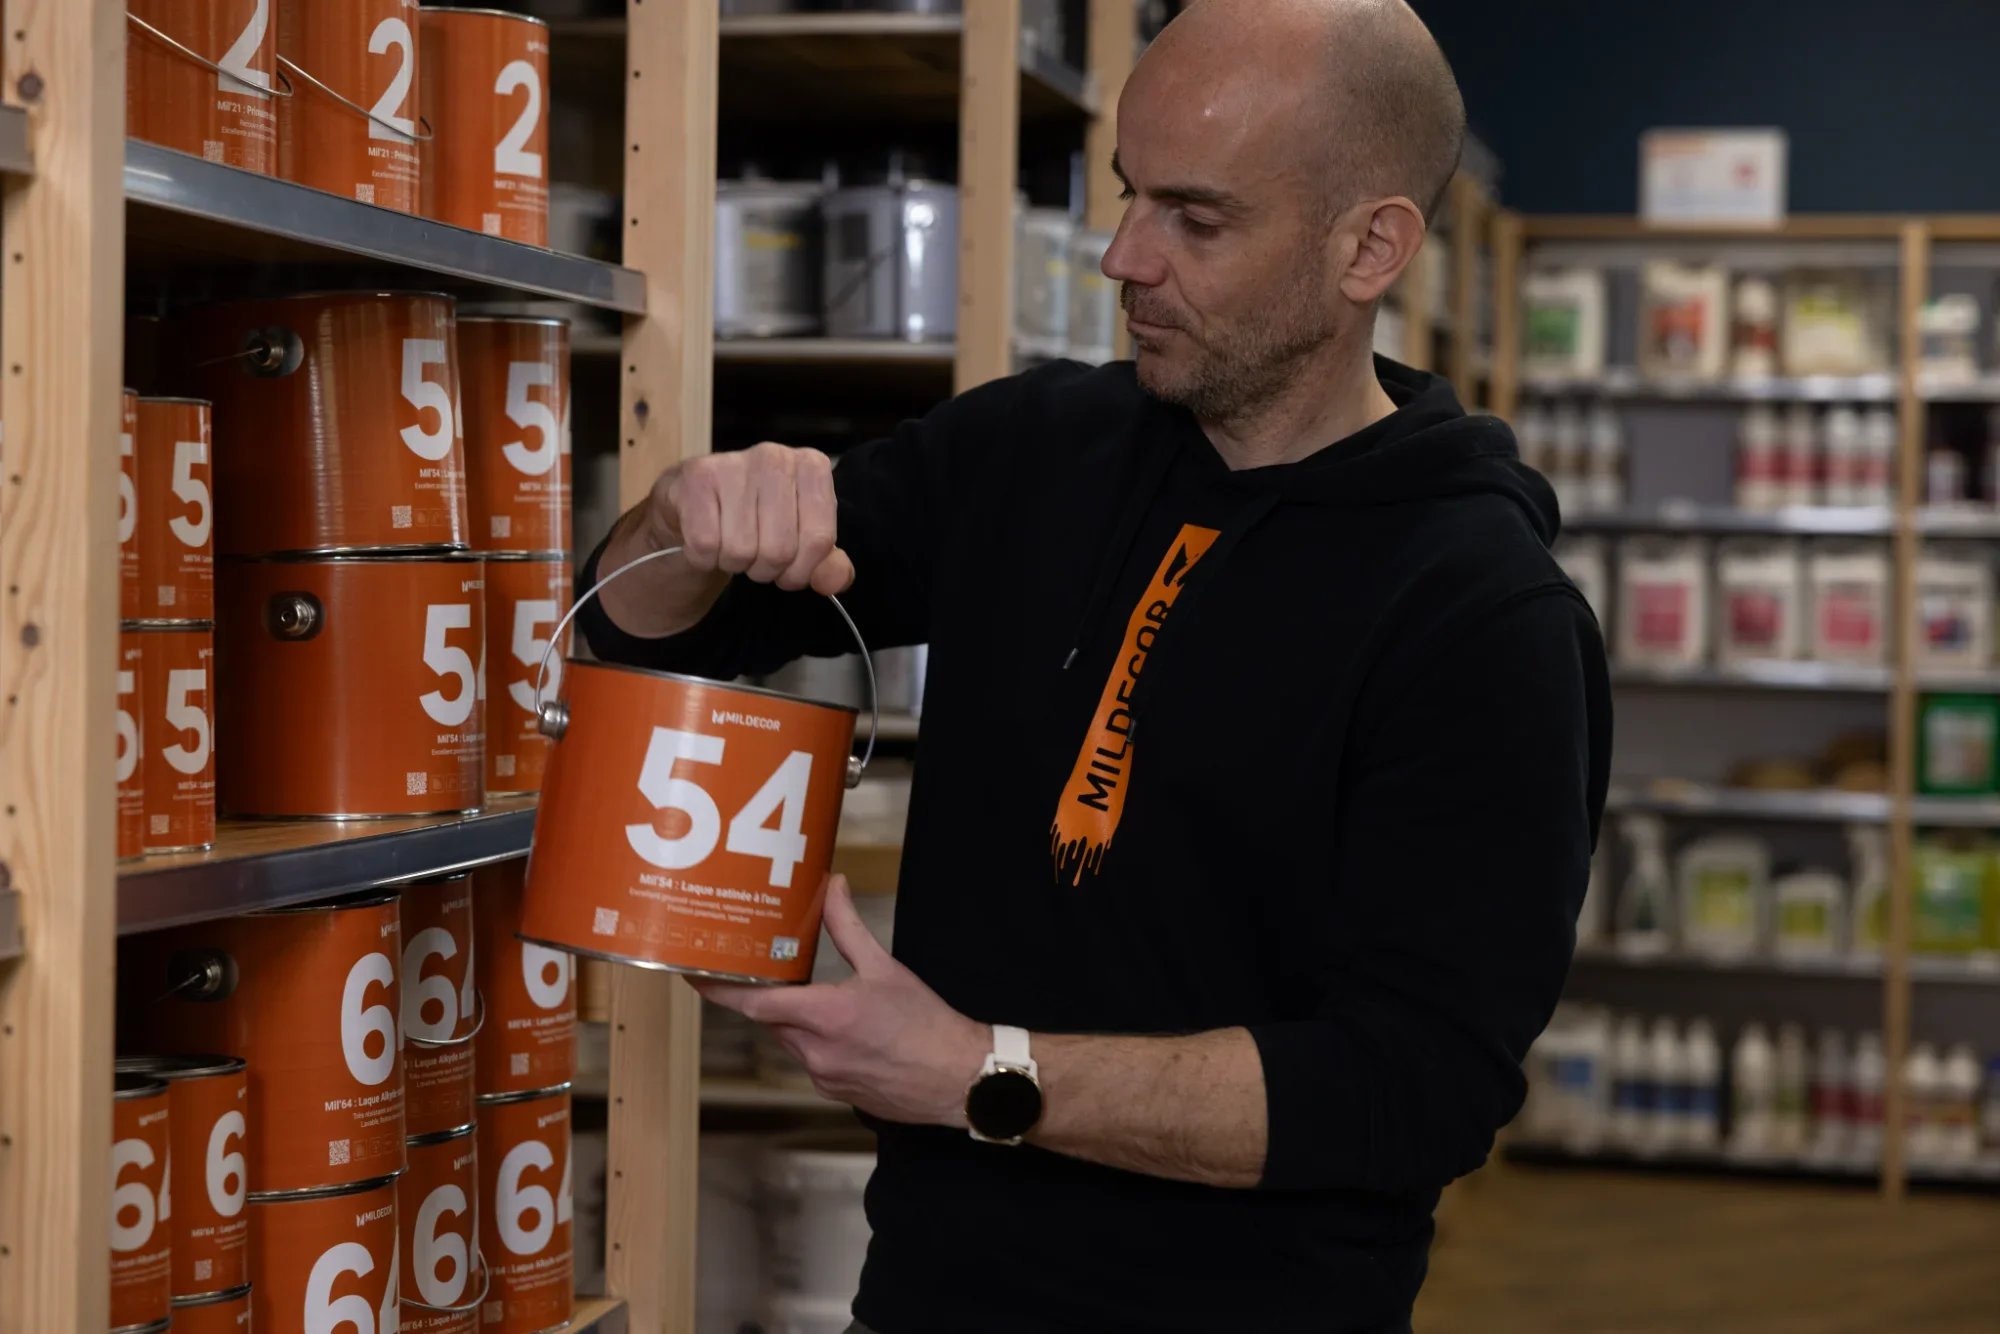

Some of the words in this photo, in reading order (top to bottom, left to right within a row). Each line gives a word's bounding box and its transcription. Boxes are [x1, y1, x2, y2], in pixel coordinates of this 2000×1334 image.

[218, 0, 270, 99] 2
[368, 17, 415, 145] 2
[495, 60, 542, 178] 2
[400, 338, 463, 461] 5
[502, 361, 571, 477] 5
[169, 441, 211, 548] 5
[419, 604, 486, 726] 5
[509, 600, 573, 713] 5
[163, 669, 215, 774] 5
[725, 710, 781, 732] MILDECOR
[625, 725, 814, 889] 54
[681, 880, 714, 897] Laque
[341, 952, 404, 1086] 6
[324, 1098, 353, 1112] Mil'64
[358, 1095, 380, 1106] Laque
[206, 1110, 246, 1217] 6
[413, 1184, 479, 1308] 6
